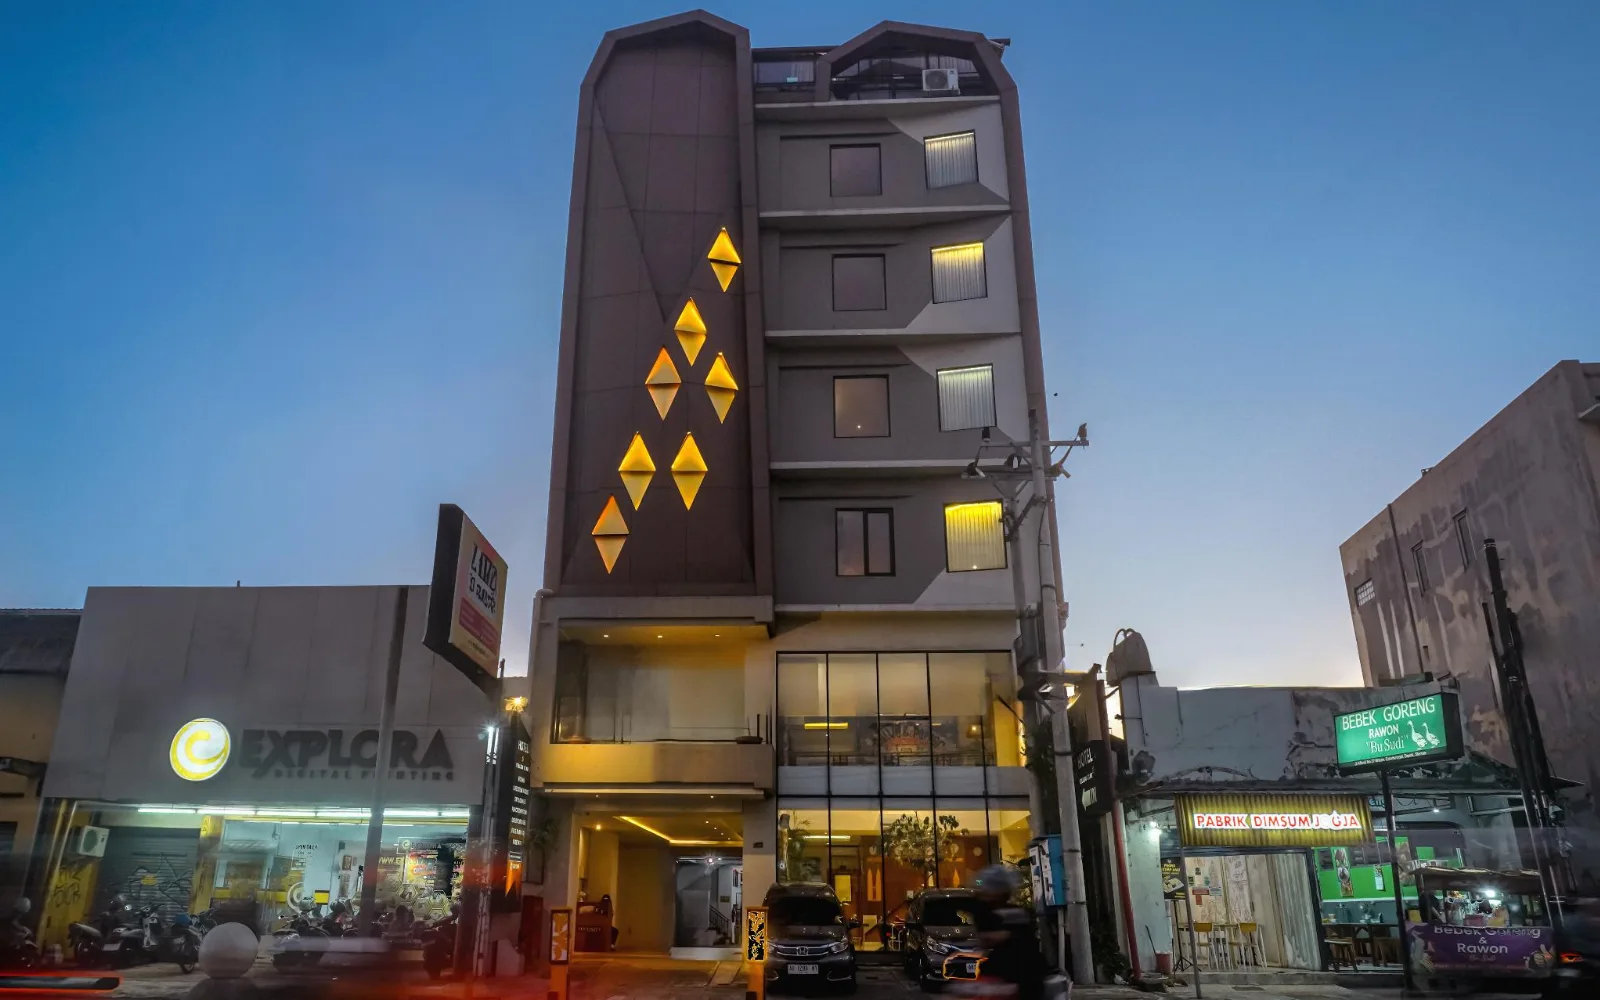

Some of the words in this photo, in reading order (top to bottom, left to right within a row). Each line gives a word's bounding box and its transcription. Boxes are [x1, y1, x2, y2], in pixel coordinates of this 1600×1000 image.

[1342, 709, 1377, 731] BEBEK
[1383, 698, 1435, 722] GORENG
[1368, 724, 1399, 739] RAWON
[239, 728, 453, 779] EXPLORA
[274, 769, 352, 780] DIGITAL
[361, 770, 454, 781] PINTING
[1196, 815, 1246, 827] PABRIK
[1253, 815, 1310, 827] DIMSUM
[1478, 936, 1488, 944] &
[1457, 943, 1508, 954] Rawon
